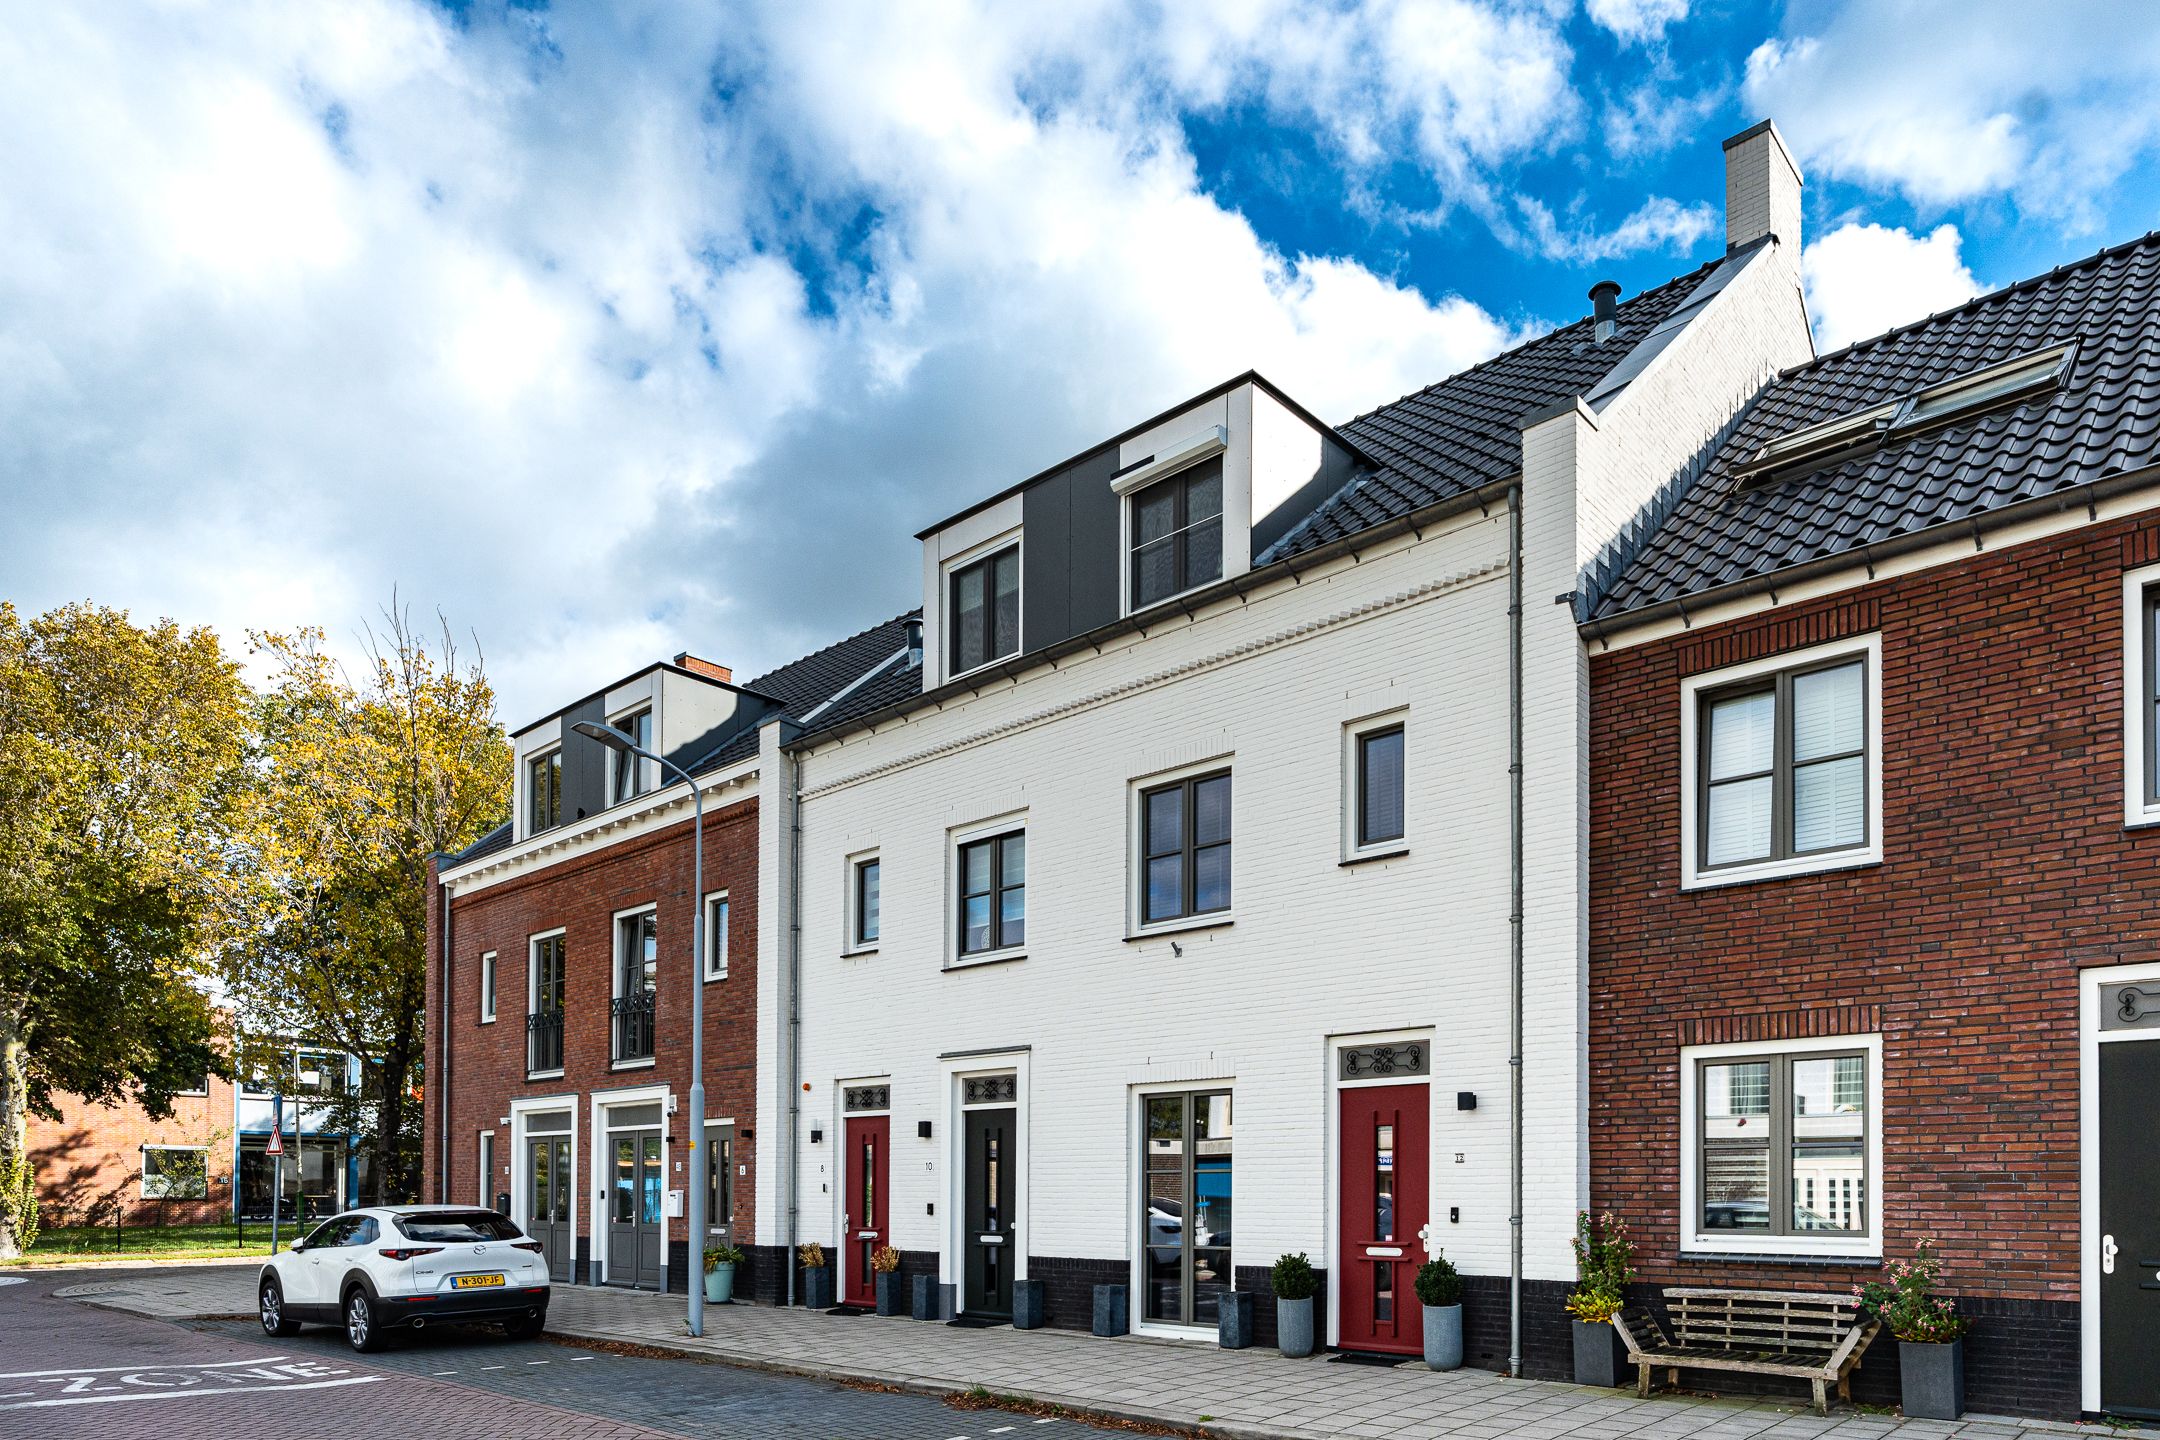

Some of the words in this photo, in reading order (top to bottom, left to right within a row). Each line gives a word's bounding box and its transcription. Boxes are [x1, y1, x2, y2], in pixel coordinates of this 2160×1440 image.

[925, 1162, 932, 1170] 10
[461, 1275, 500, 1286] N-301-JF
[37, 1362, 351, 1393] ZONE
